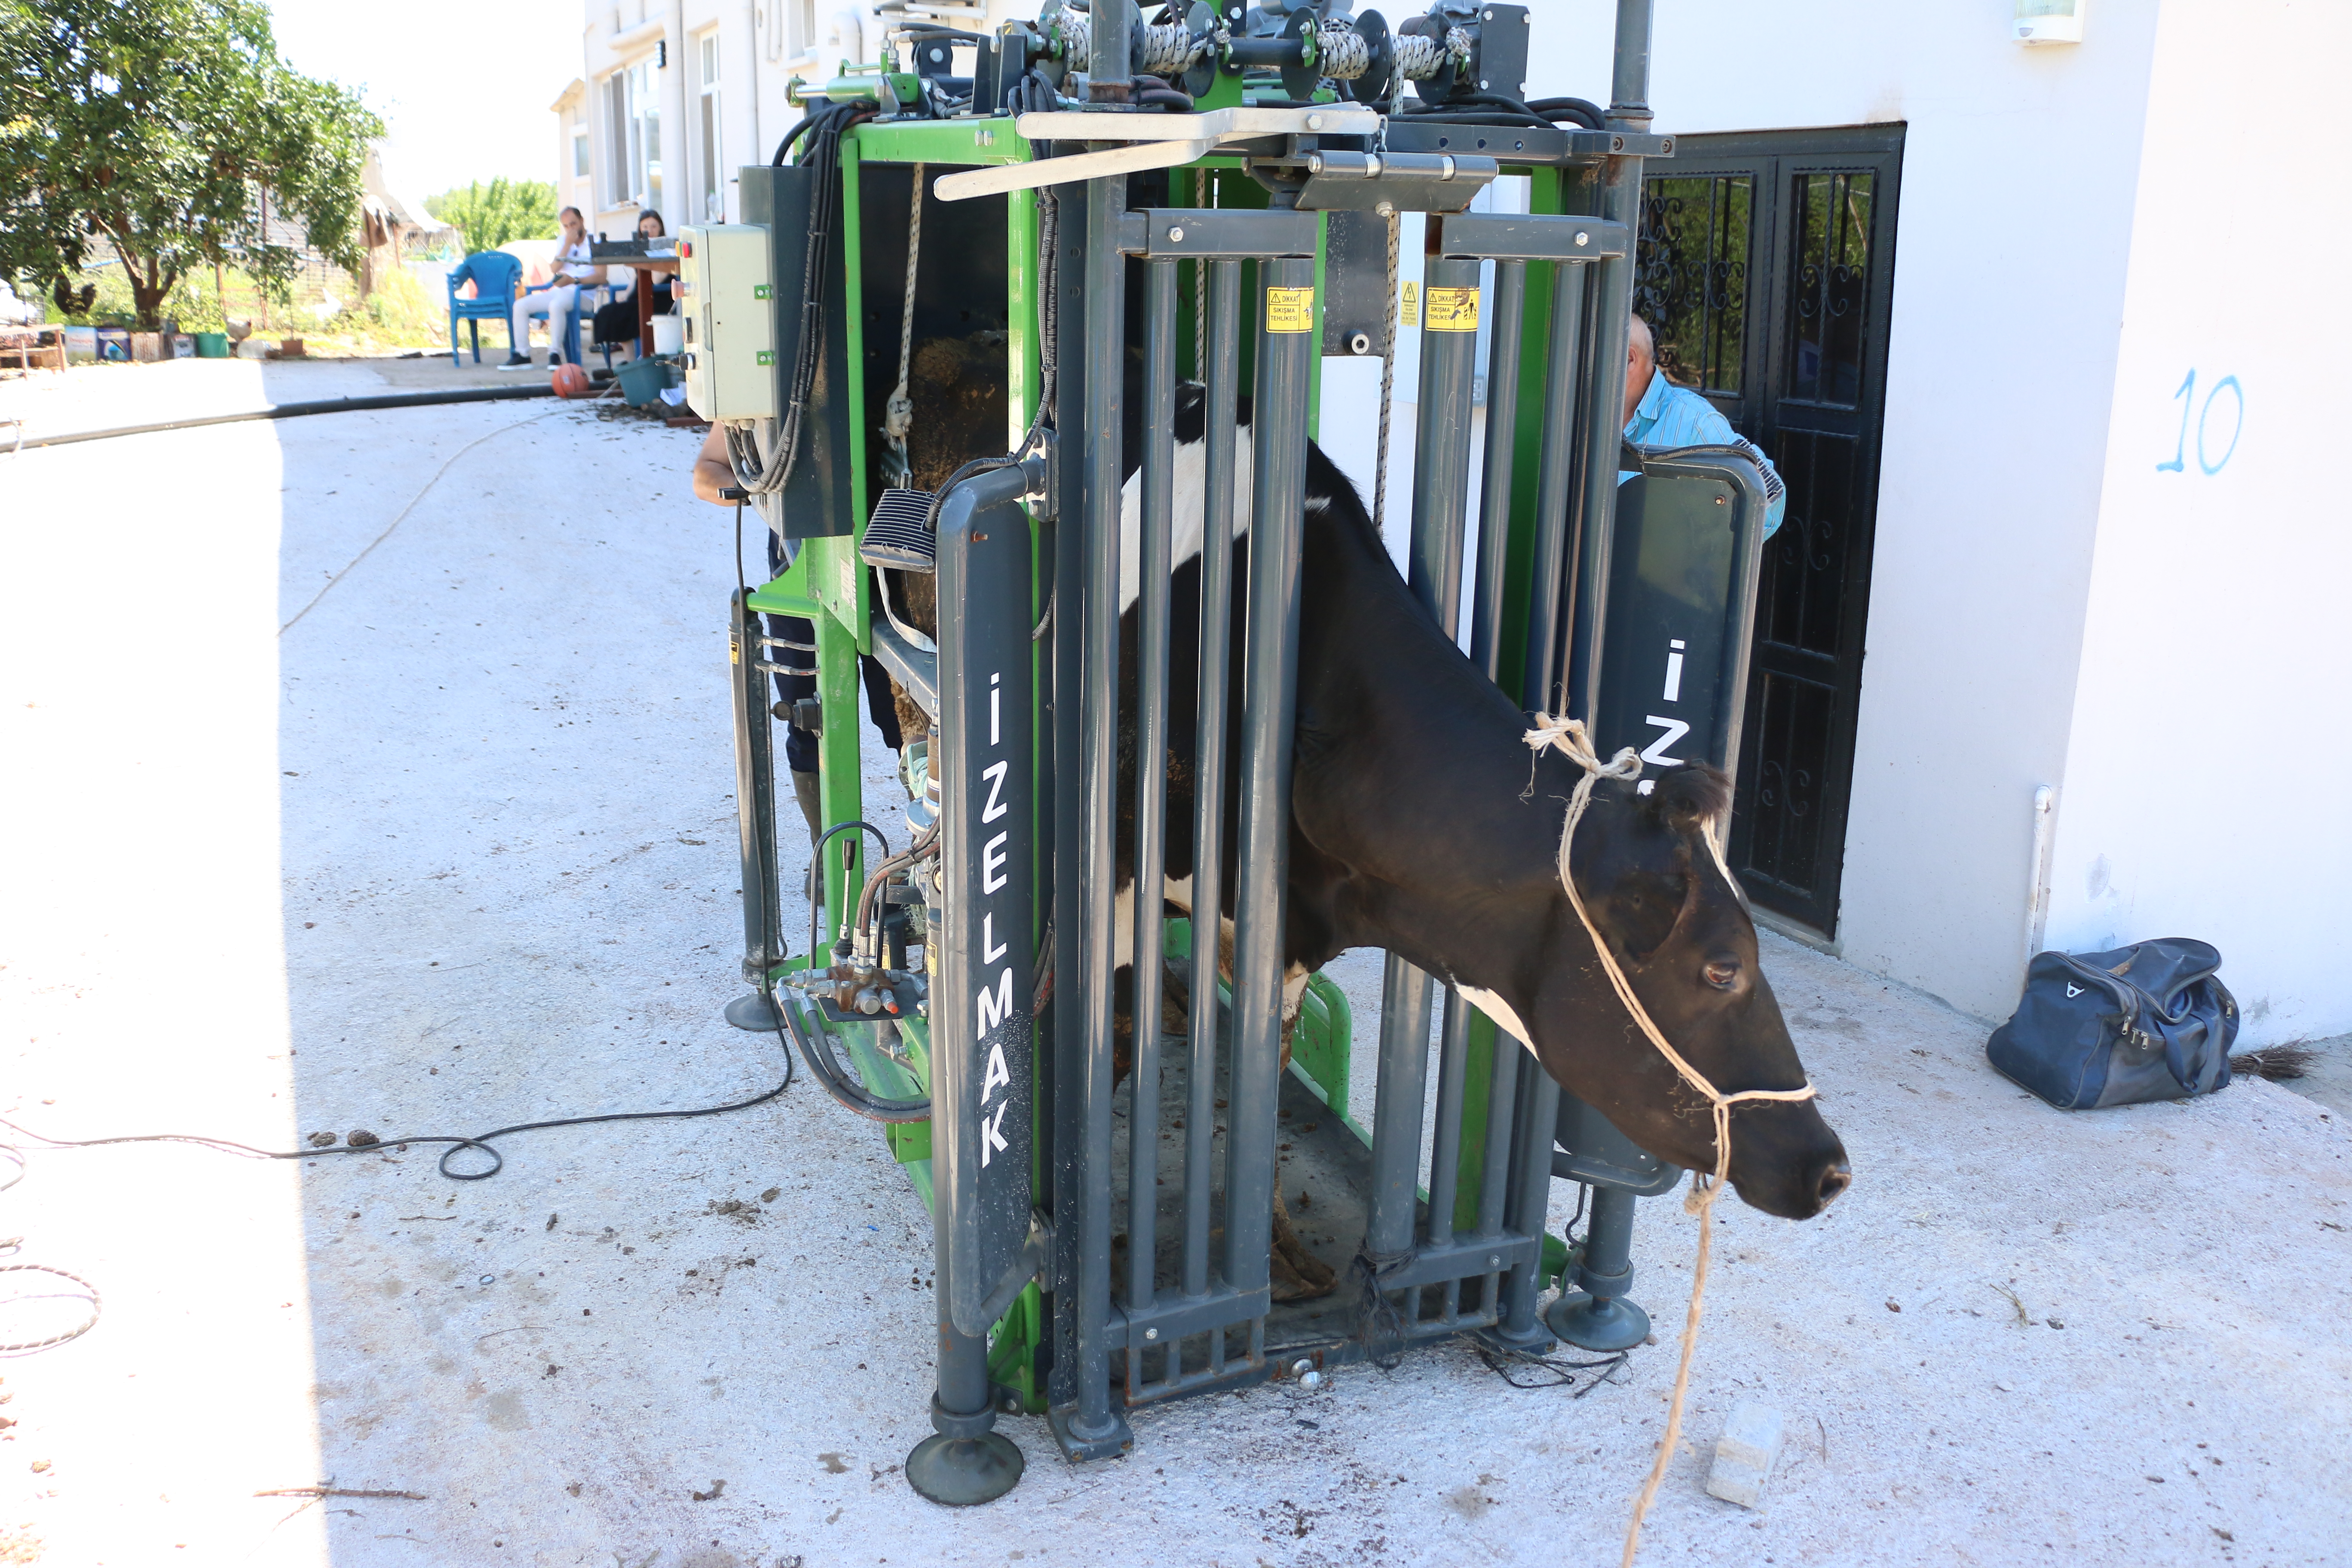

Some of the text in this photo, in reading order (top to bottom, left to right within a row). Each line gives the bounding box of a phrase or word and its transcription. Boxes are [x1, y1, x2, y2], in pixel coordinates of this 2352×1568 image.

[1282, 294, 1298, 302] DİKKAT
[1438, 294, 1455, 302] DİKKAT
[2156, 367, 2244, 477] 10
[977, 671, 1013, 1169] İZELMAK
